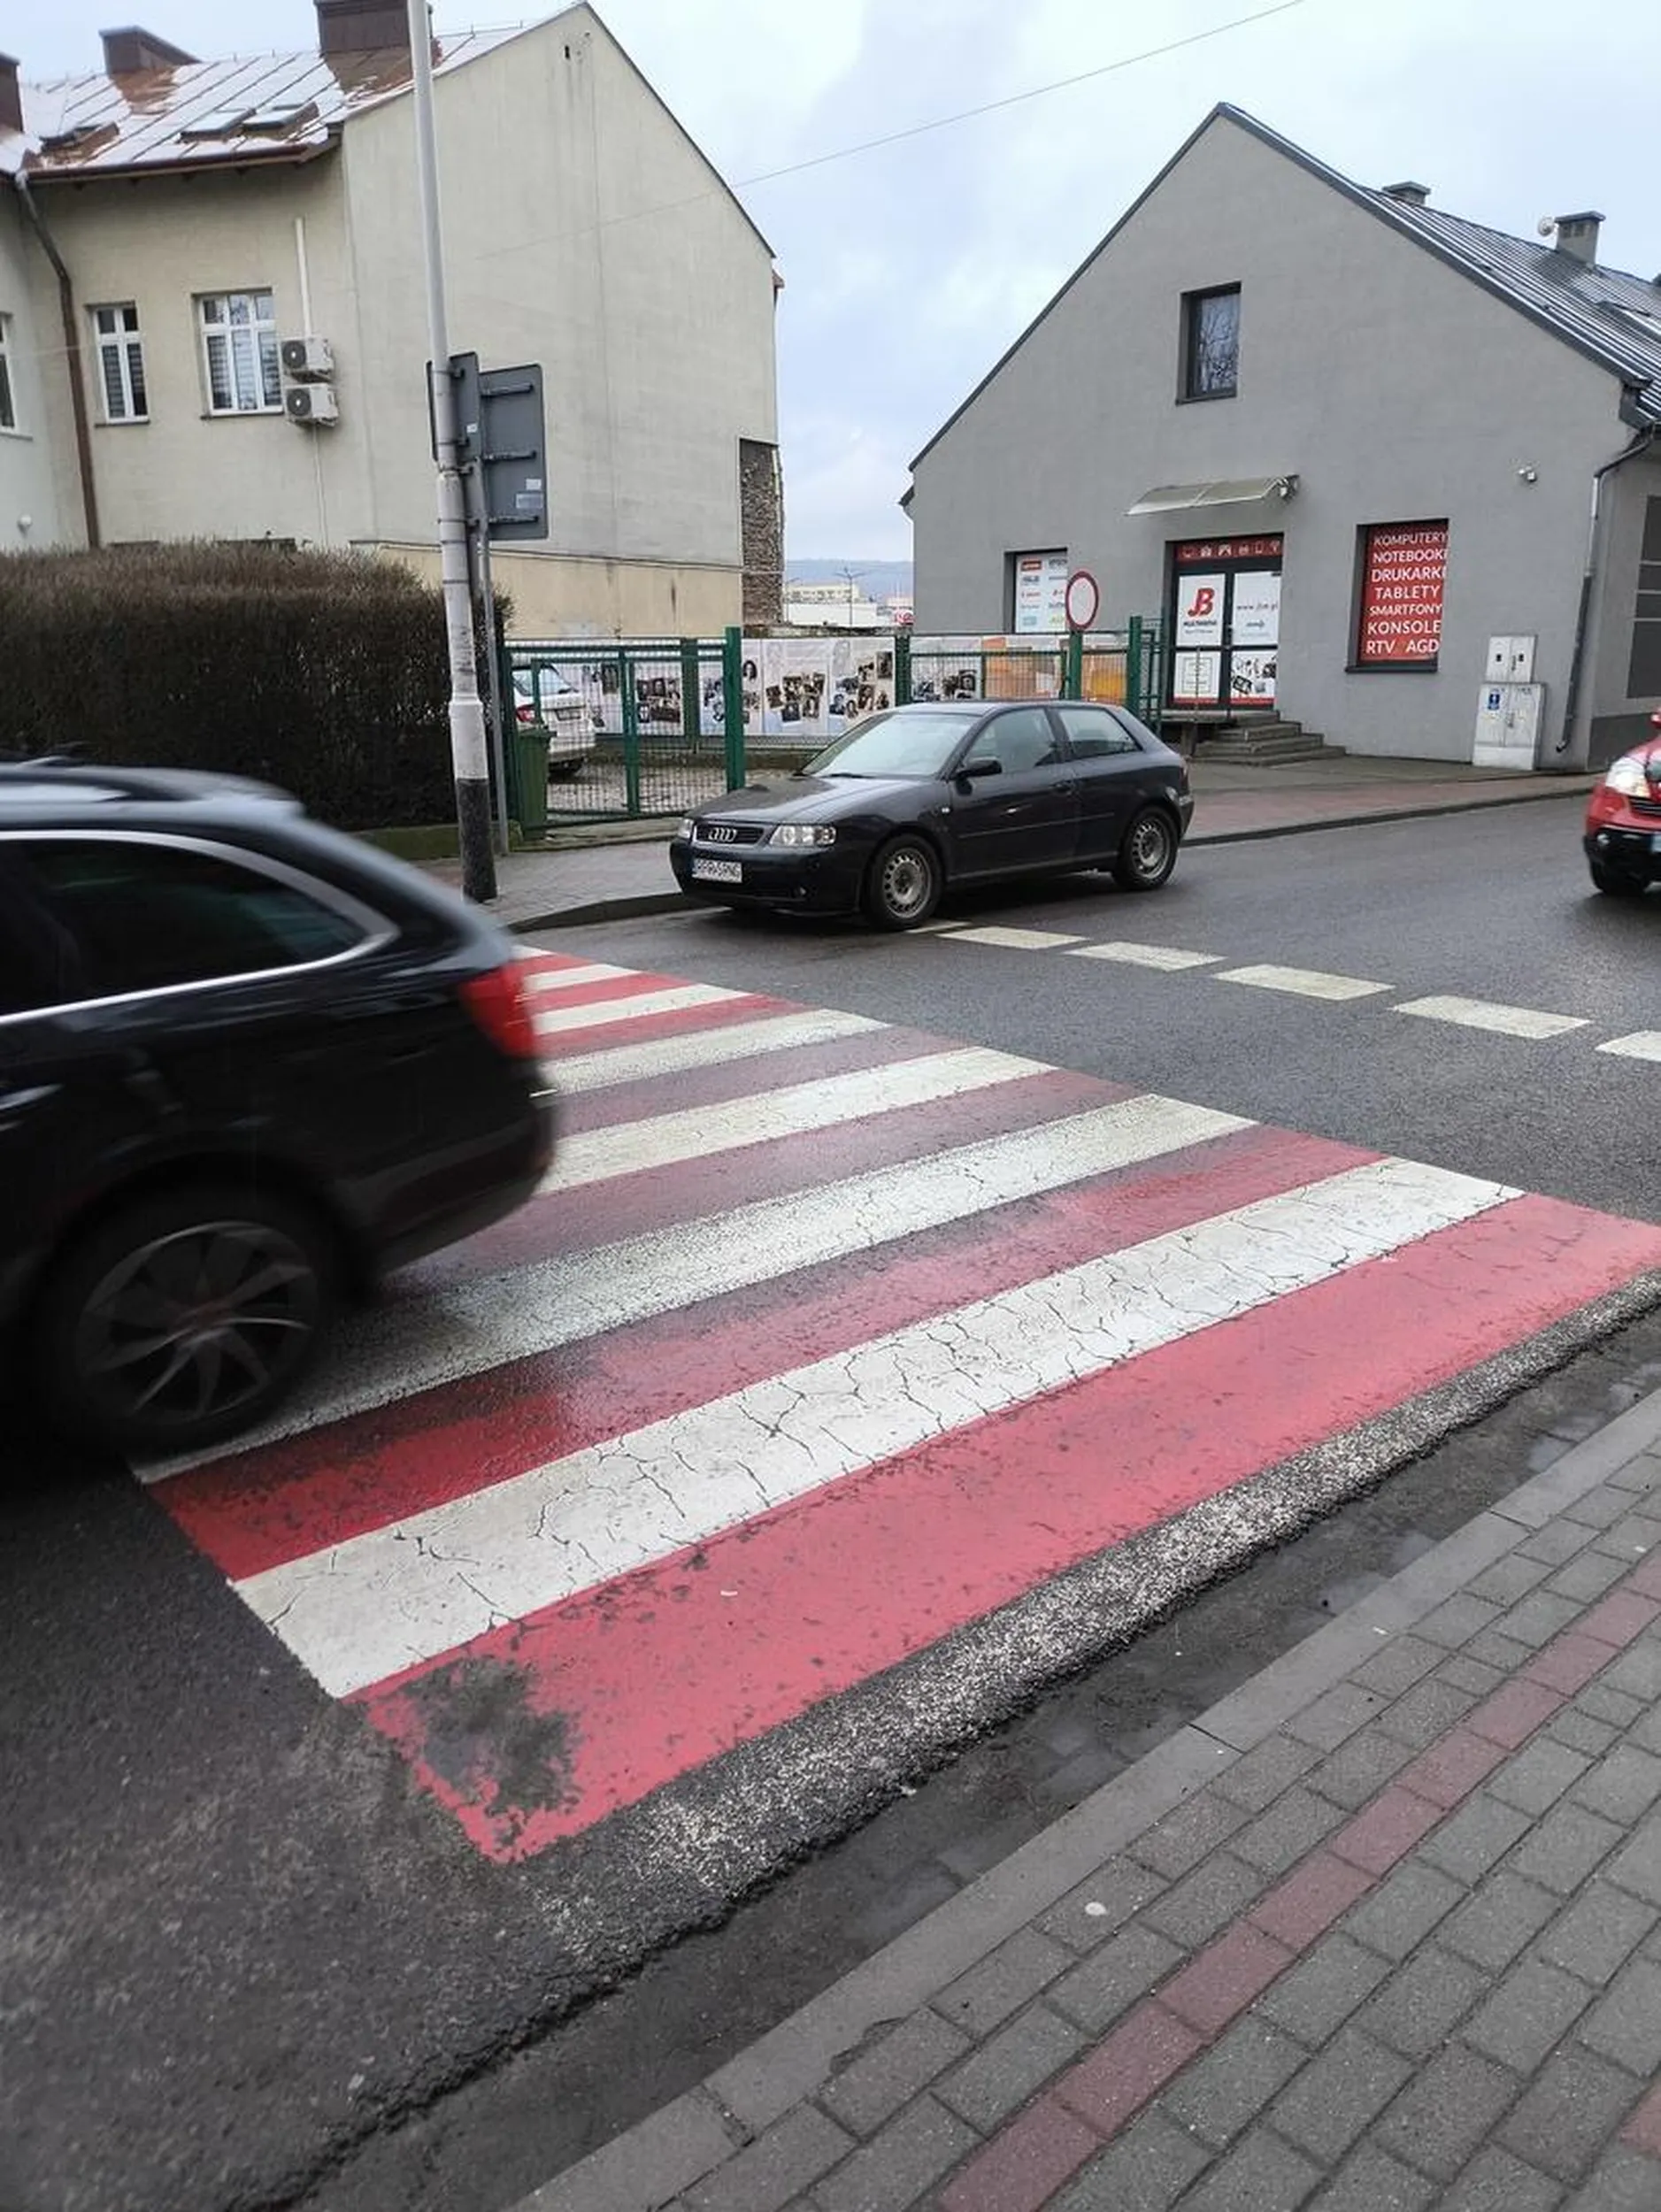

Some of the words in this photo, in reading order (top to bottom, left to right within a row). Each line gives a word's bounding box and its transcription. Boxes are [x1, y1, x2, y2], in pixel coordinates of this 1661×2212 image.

[1373, 532, 1445, 546] KOMPUTERY
[1374, 585, 1441, 601] TABLETY
[1369, 603, 1442, 617] SMARTFONY
[1367, 619, 1442, 634] KONSOLE
[1365, 639, 1396, 654] RTV
[1405, 638, 1440, 653] AGD
